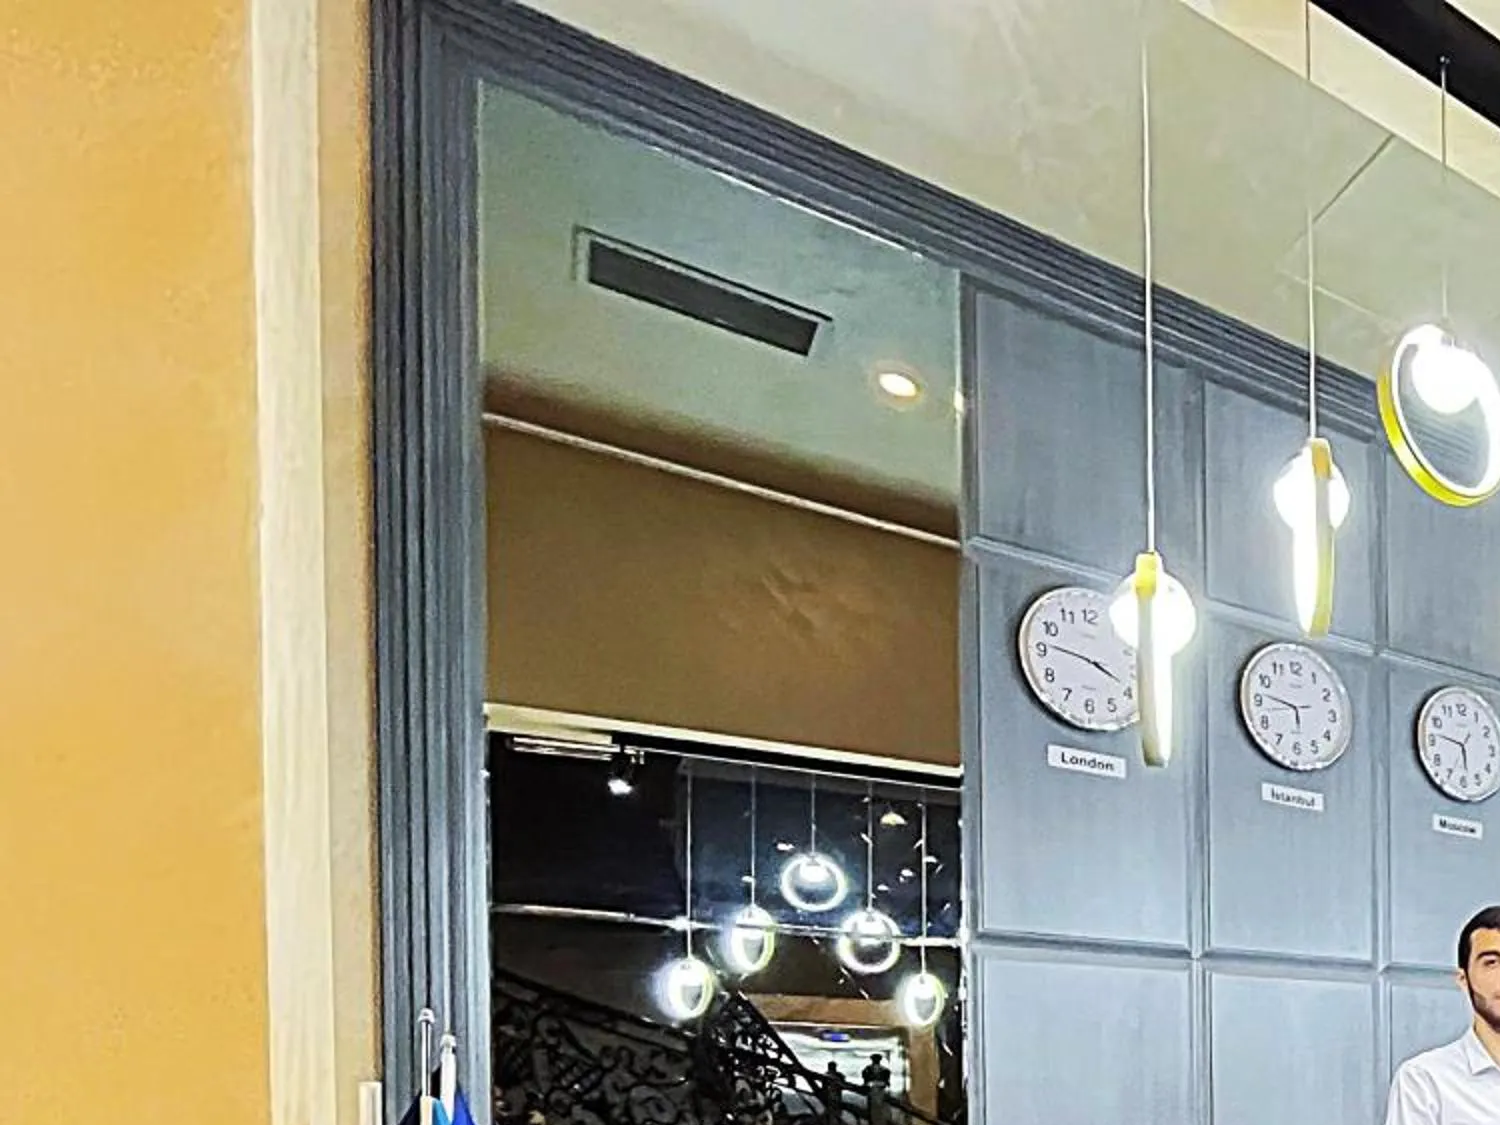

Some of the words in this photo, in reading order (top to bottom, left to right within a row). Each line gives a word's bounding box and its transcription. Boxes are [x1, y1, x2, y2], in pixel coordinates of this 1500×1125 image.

[1060, 607, 1075, 624] 11
[1081, 608, 1098, 626] 12
[1042, 621, 1059, 637] 10
[1035, 641, 1047, 657] 9
[1044, 667, 1055, 682] 8
[1272, 661, 1284, 676] 11
[1289, 661, 1303, 676] 12
[1259, 674, 1271, 688] 10
[1311, 671, 1317, 685] 1
[1062, 687, 1072, 701] 7
[1123, 686, 1133, 699] 4
[1322, 687, 1331, 702] 2
[1084, 698, 1095, 714] 6
[1106, 697, 1117, 712] 5
[1254, 693, 1263, 707] 9
[1327, 709, 1337, 723] 3
[1441, 703, 1452, 718] 11
[1455, 703, 1467, 717] 12
[1473, 711, 1479, 723] 1
[1261, 714, 1269, 730] 8
[1431, 717, 1442, 729] 10
[1275, 732, 1283, 745] 7
[1323, 729, 1331, 741] 4
[1482, 725, 1491, 739] 2
[1292, 742, 1302, 755] 6
[1310, 739, 1319, 754] 5
[1060, 751, 1115, 772] London
[1446, 767, 1453, 780] 7
